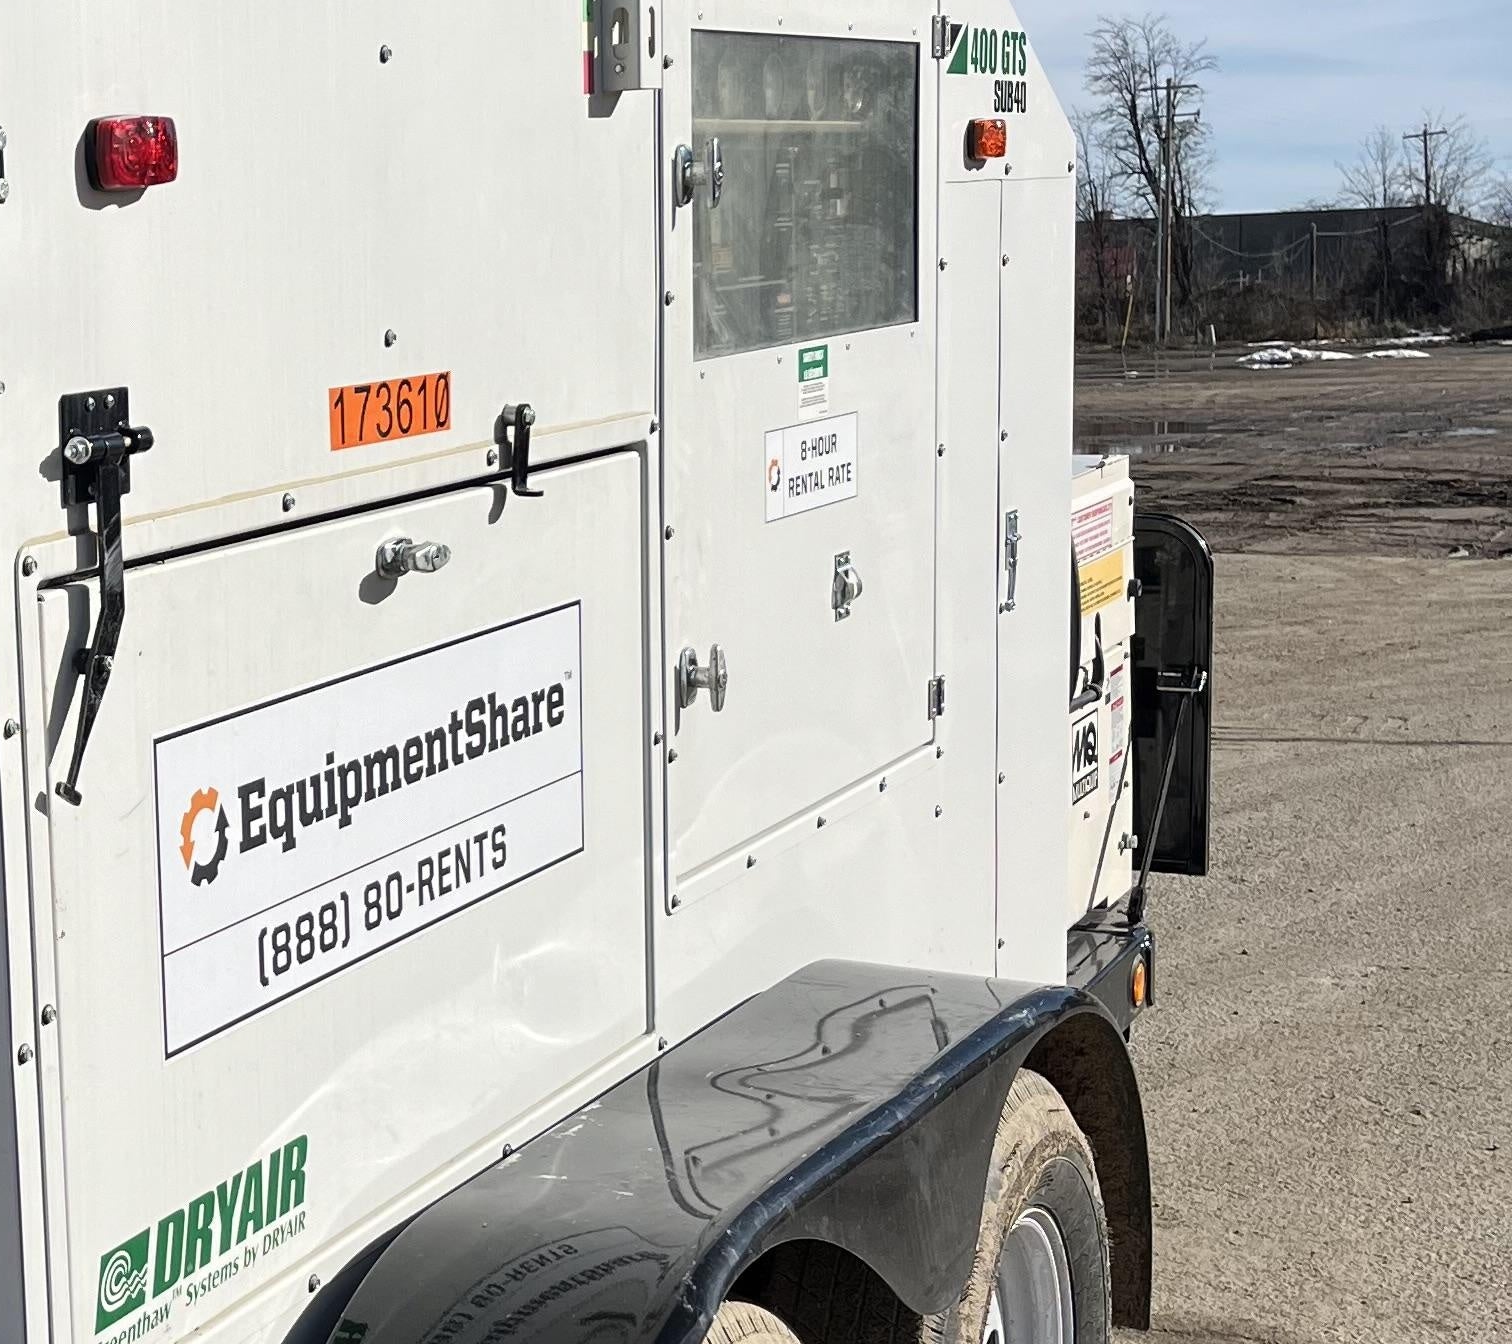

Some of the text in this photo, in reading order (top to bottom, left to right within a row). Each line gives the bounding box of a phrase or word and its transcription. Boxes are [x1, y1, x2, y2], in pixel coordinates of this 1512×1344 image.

[970, 28, 1027, 76] 400 GTS
[993, 79, 1027, 113] SUB40
[334, 371, 450, 445] 173610
[788, 462, 852, 498] RENTAL RATE
[800, 433, 837, 461] 8-HOUR
[238, 682, 564, 854] EquipmentShare
[257, 823, 507, 987] (888) 80-RENTS
[152, 1134, 308, 1299] DRYAIR
[185, 1257, 239, 1307] Systems
[243, 1243, 260, 1268] by
[262, 1210, 306, 1256] DRYAIR
